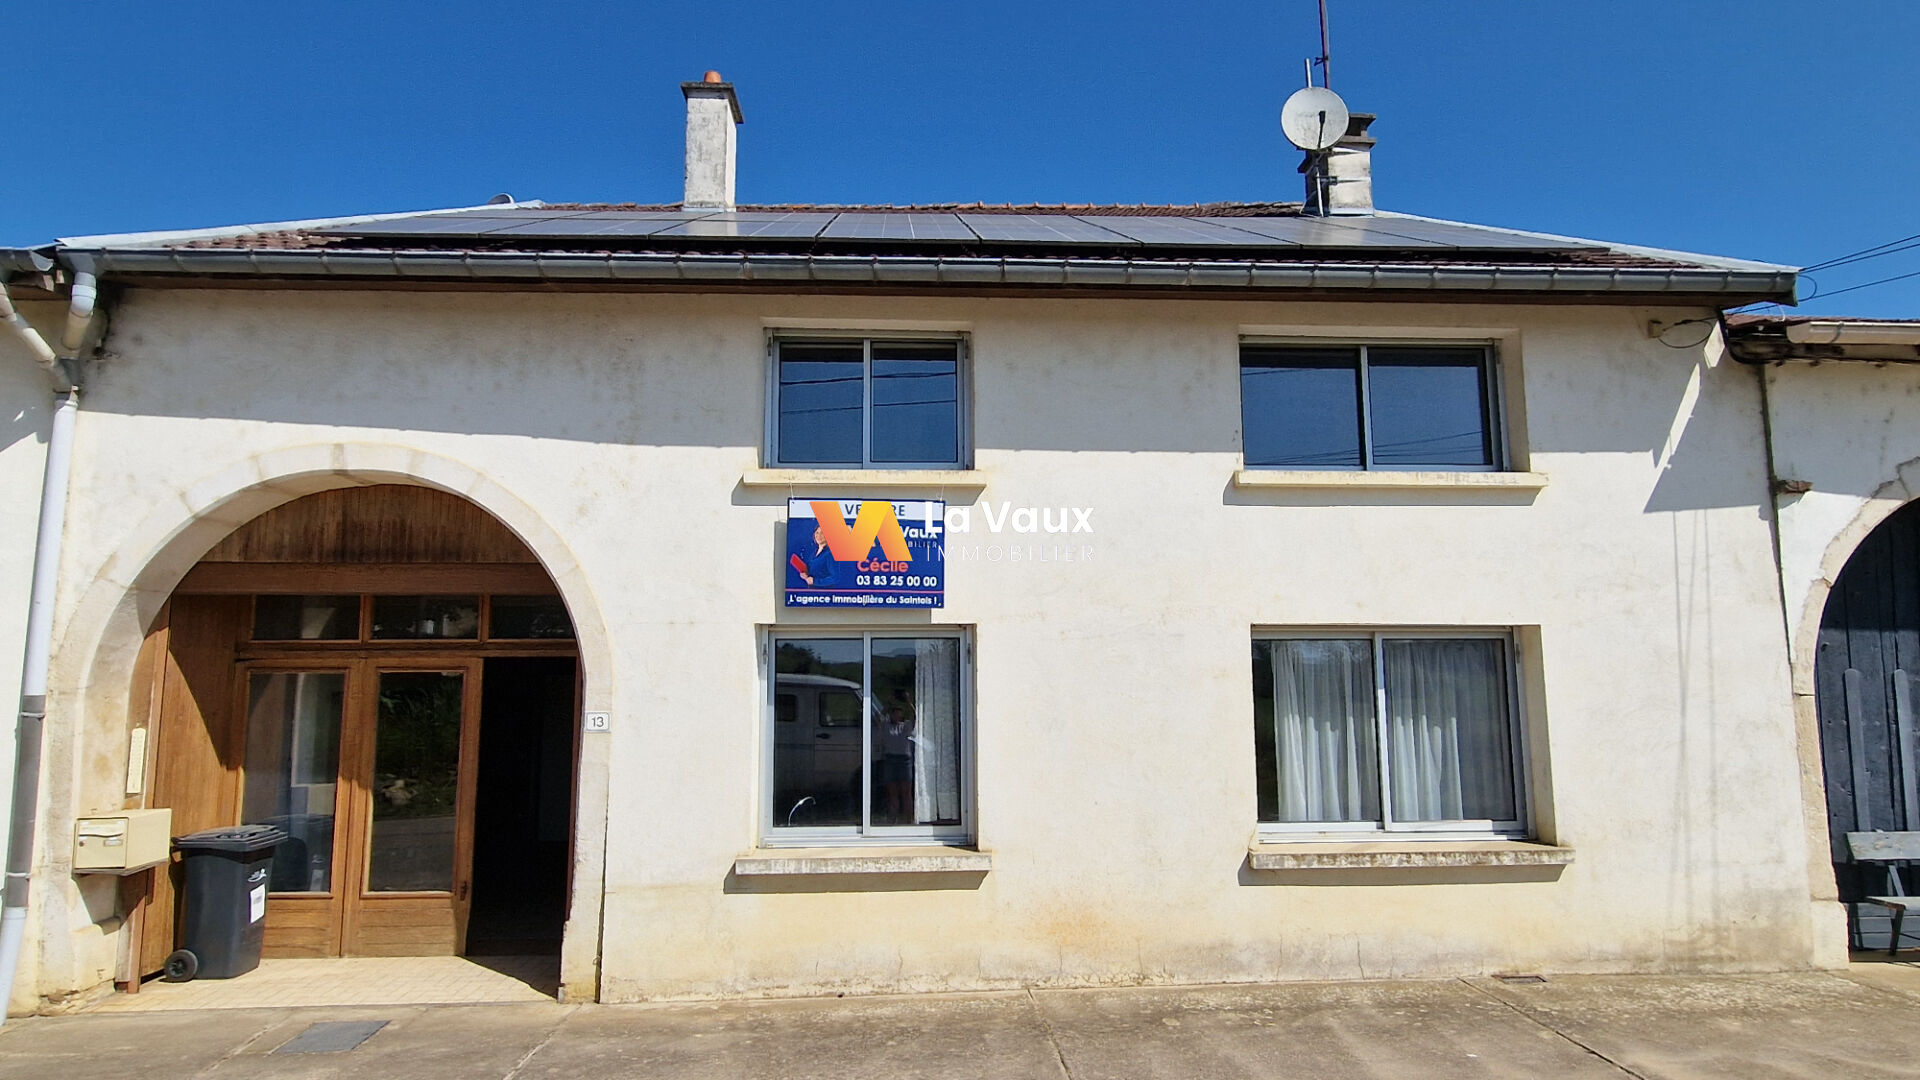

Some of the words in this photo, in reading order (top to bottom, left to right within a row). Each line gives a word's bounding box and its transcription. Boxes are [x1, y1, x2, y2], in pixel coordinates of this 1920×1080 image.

[857, 557, 909, 573] Cécile
[856, 575, 871, 586] 03
[873, 575, 887, 586] 83
[890, 576, 904, 587] 25
[906, 576, 921, 587] 00
[923, 576, 937, 587] 00
[789, 594, 831, 604] L'agence
[885, 594, 898, 604] du
[592, 716, 604, 727] 13
